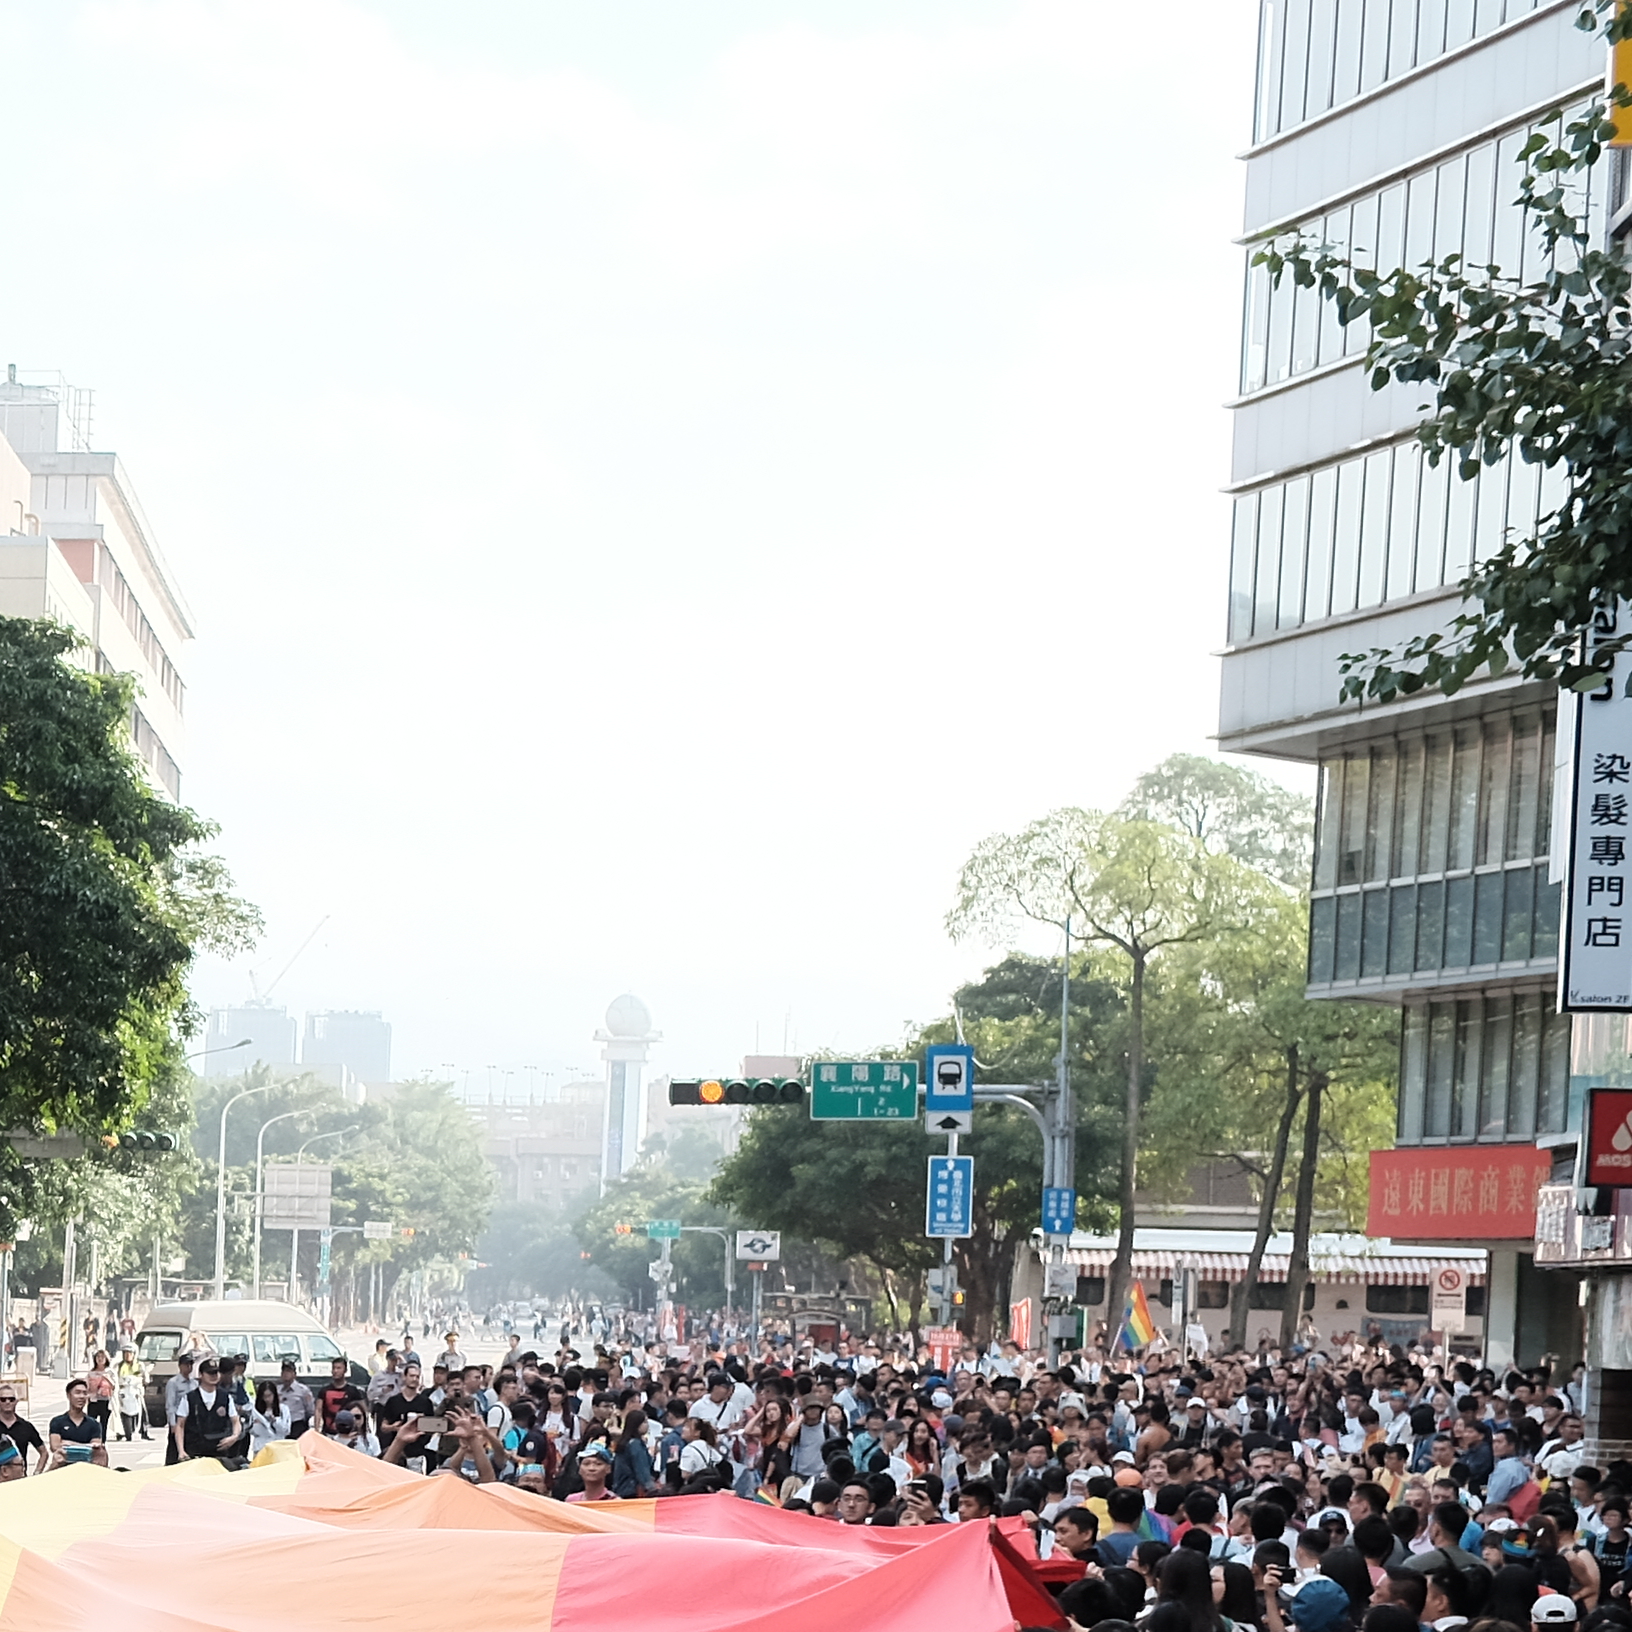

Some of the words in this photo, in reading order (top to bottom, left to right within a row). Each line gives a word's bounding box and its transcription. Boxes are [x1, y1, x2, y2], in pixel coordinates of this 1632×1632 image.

[1584, 753, 1631, 948] 染髮專門店
[1595, 1153, 1631, 1168] MOS
